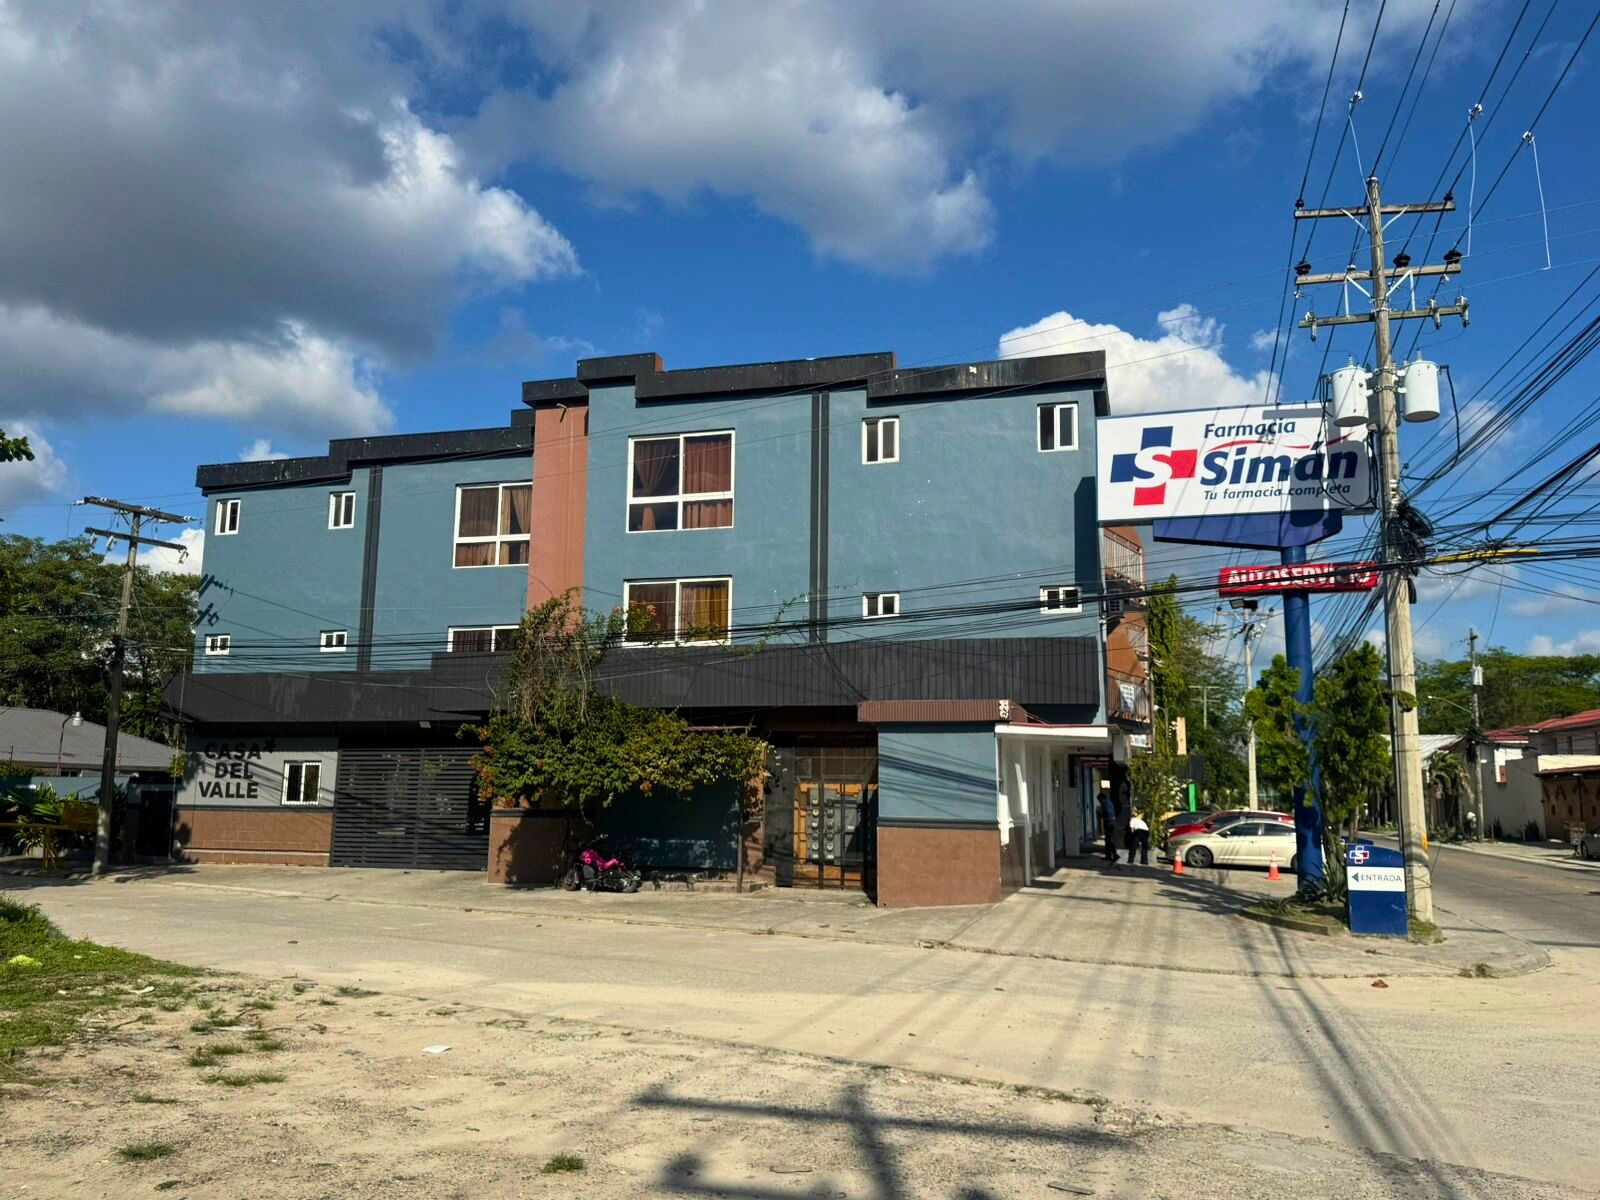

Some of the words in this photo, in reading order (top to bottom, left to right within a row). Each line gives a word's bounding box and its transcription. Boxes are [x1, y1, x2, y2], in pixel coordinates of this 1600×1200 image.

[1203, 417, 1296, 439] Farmacia
[1200, 440, 1358, 486] Simán
[1204, 490, 1218, 500] Tu
[1223, 487, 1282, 500] farmacia
[1288, 483, 1351, 501] completa
[204, 743, 261, 759] CASA
[215, 762, 254, 779] DEL
[199, 781, 259, 799] VALLE
[1361, 874, 1402, 882] ENTRADA
